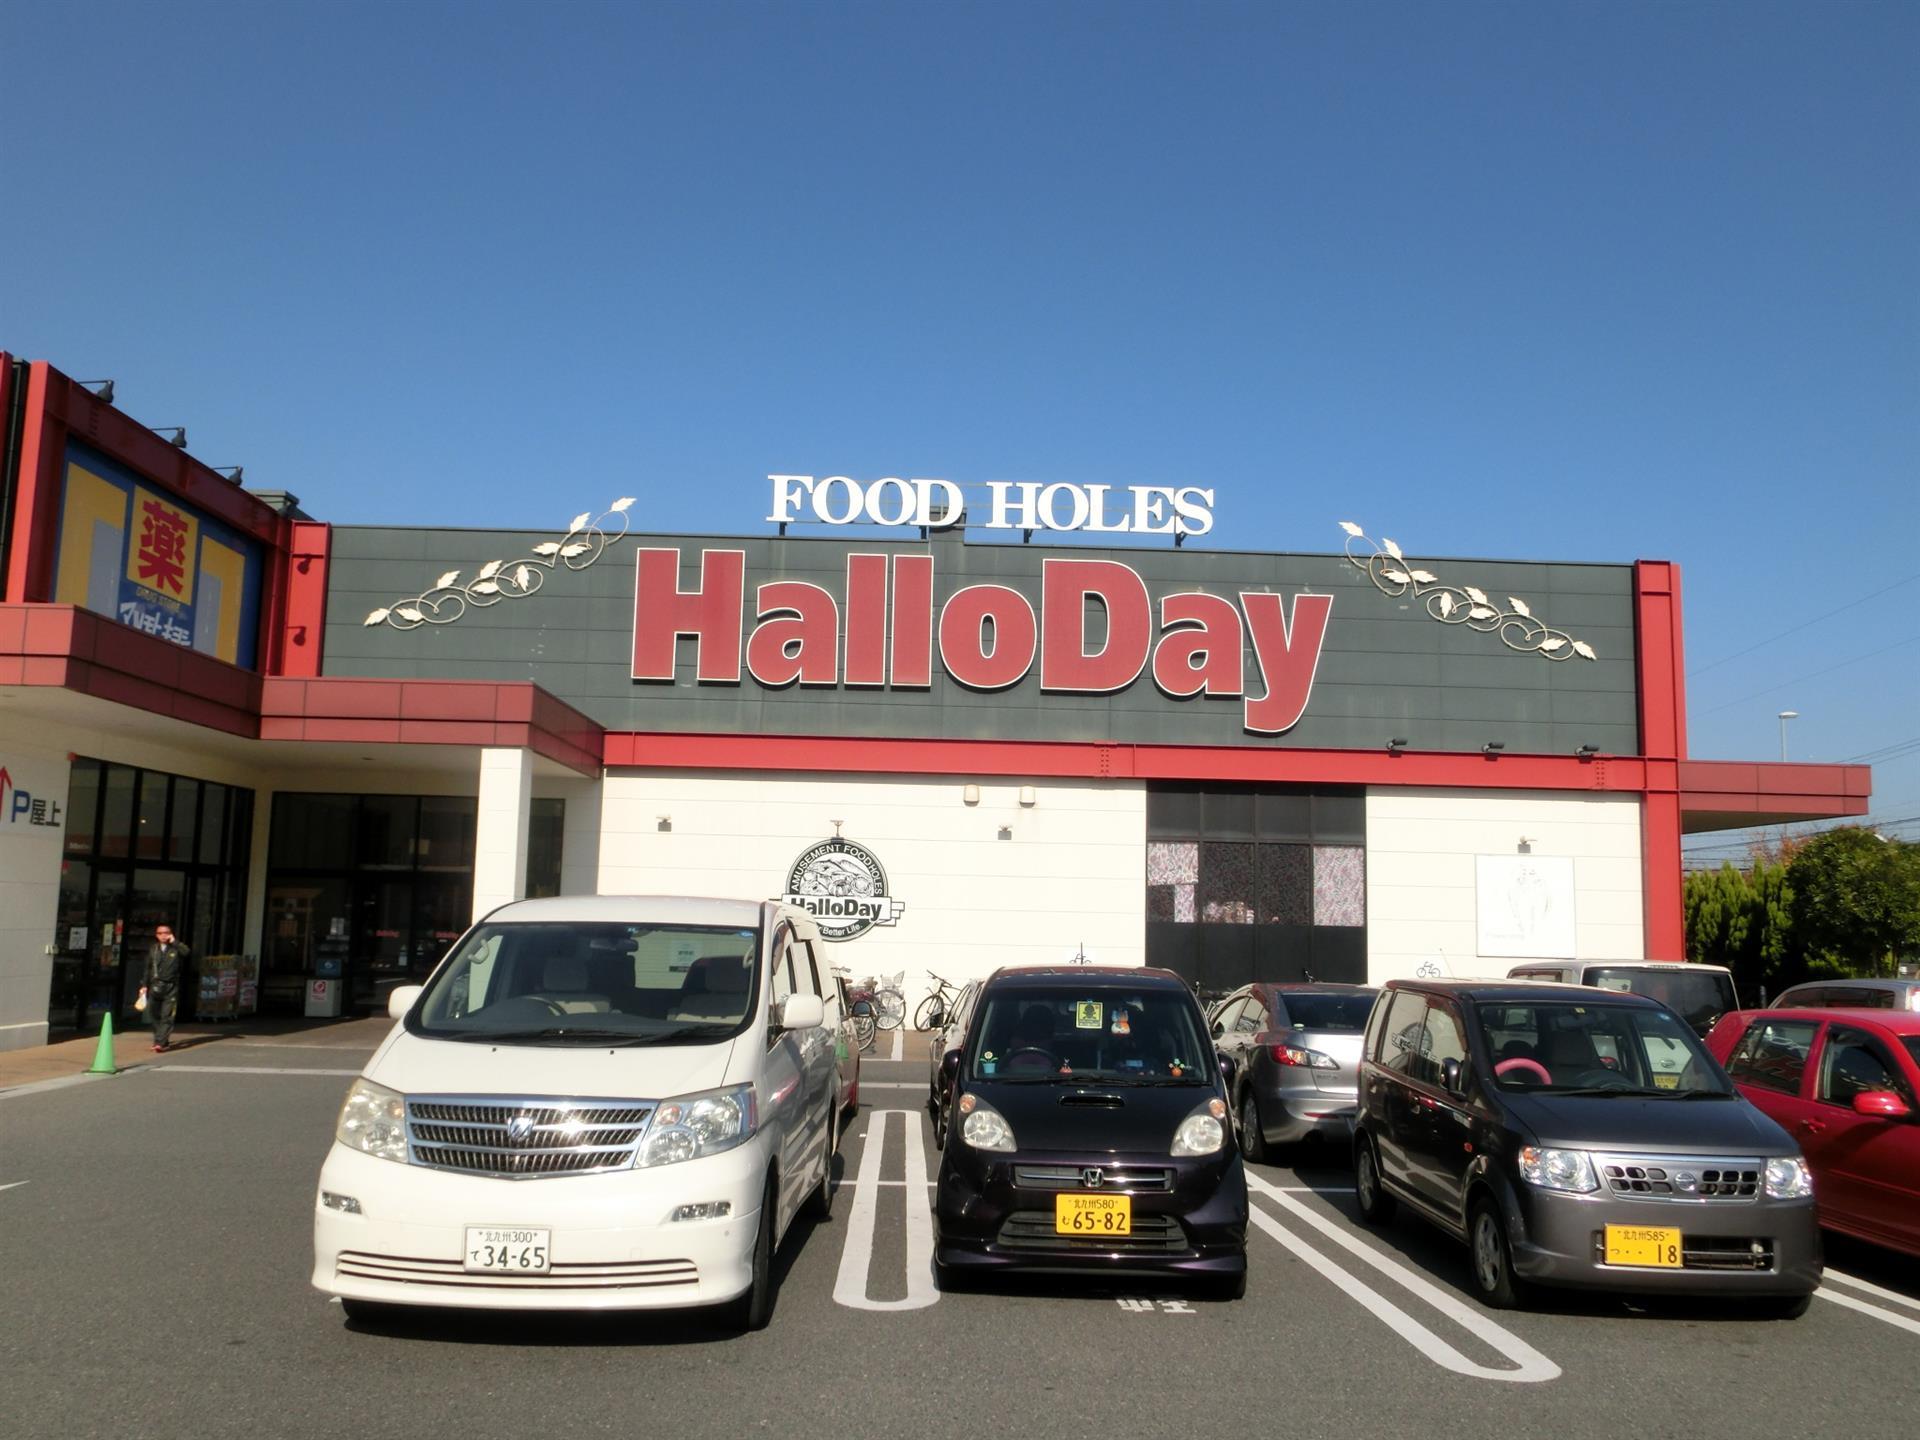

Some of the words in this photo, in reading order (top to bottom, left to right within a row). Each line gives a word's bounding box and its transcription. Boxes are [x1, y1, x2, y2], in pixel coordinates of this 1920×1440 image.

[766, 474, 965, 527] FOOD
[985, 481, 1215, 536] HOLES
[138, 499, 189, 595] 薬
[630, 546, 1335, 734] HalloDay
[791, 844, 841, 891] AMUSEMENT
[1073, 1211, 1126, 1231] 65-82
[483, 1245, 545, 1268] 34-65
